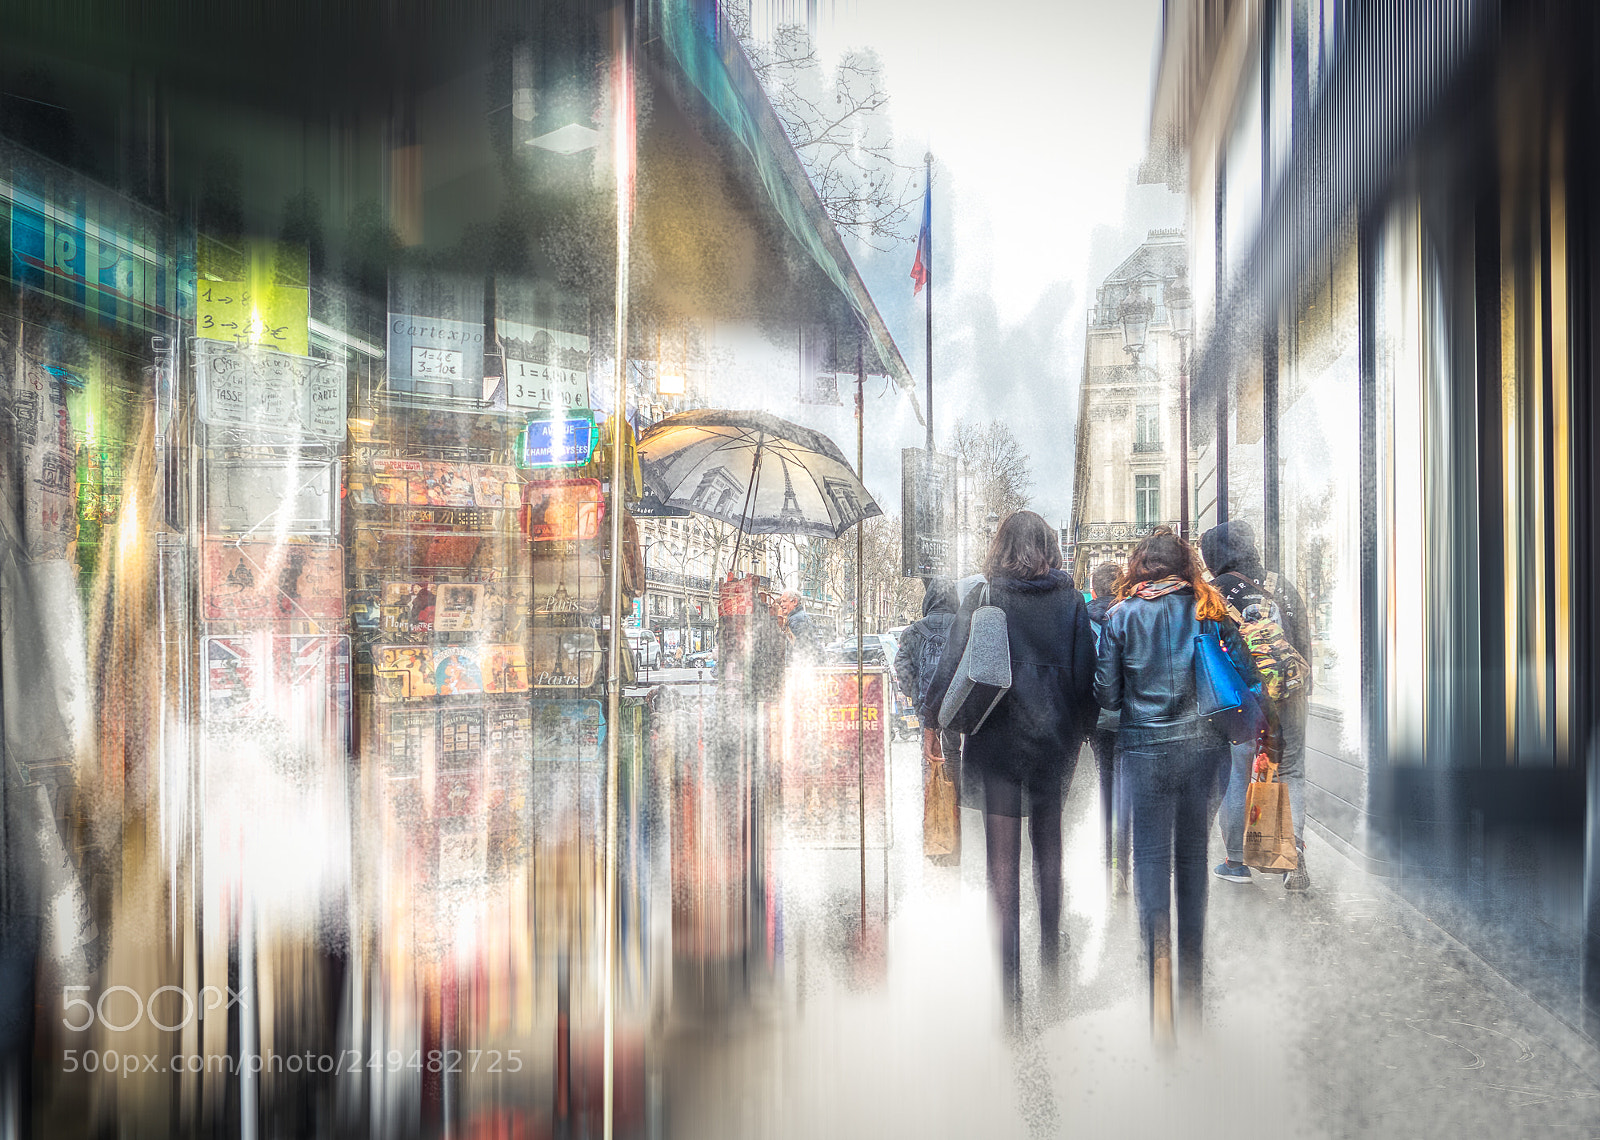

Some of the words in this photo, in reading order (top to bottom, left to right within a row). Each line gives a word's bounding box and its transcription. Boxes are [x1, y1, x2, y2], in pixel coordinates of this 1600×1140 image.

[202, 288, 212, 302] 1
[202, 314, 215, 329] 3
[393, 320, 483, 345] Cartexpo
[519, 364, 526, 377] 1
[570, 373, 577, 386] €
[215, 388, 244, 403] TASSE
[312, 388, 338, 403] CARTE
[516, 384, 524, 398] 3
[575, 394, 583, 407] €
[545, 595, 579, 612] Paris
[536, 670, 579, 686] Paris
